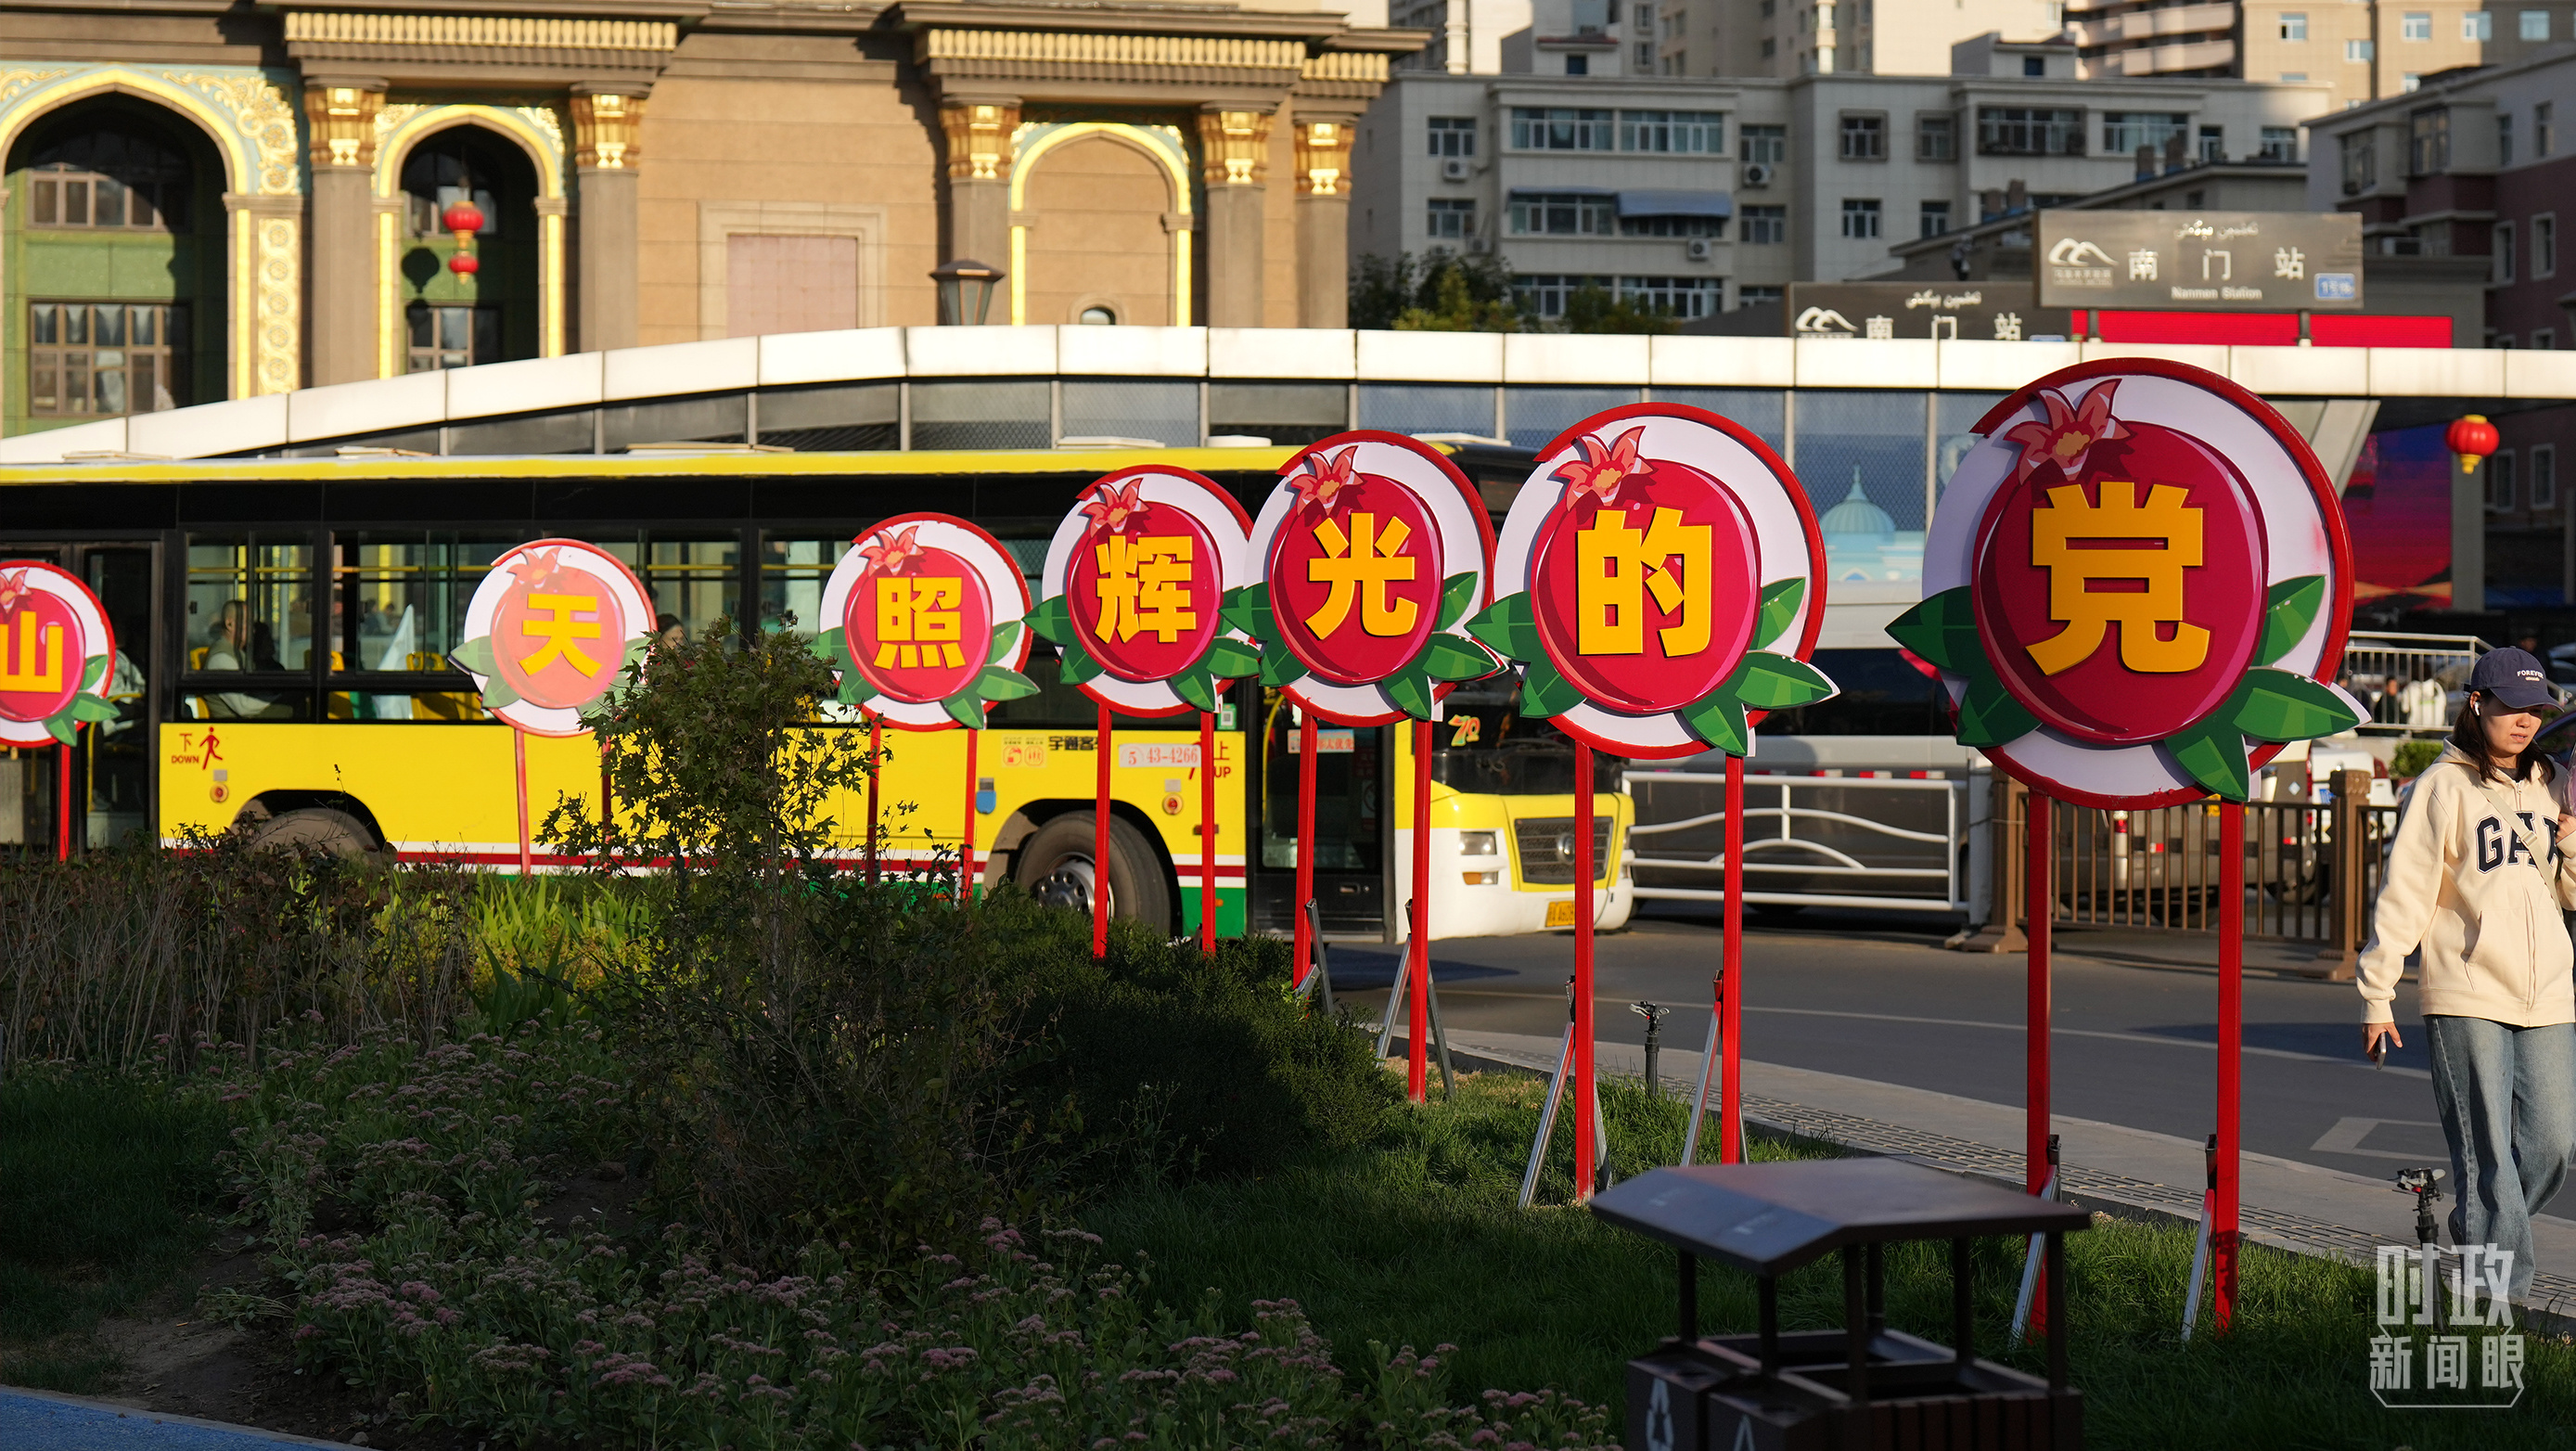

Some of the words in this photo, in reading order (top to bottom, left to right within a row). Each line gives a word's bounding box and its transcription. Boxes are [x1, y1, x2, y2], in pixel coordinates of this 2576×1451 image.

[2127, 246, 2306, 281] 南门站
[2172, 286, 2218, 300] Nanmen
[2222, 286, 2262, 300] Station
[1865, 312, 2022, 340] 南门站
[1095, 534, 1197, 644] 辉
[1304, 512, 1418, 640] 光
[1577, 507, 1712, 658] 的
[2028, 479, 2210, 675] 党
[519, 592, 603, 679] 天
[873, 576, 967, 670] 照
[0, 610, 64, 693] 山
[171, 755, 199, 764] DOWN
[179, 733, 193, 751] 下
[1146, 745, 1199, 764] 43-4266
[1212, 740, 1230, 761] 上
[1212, 766, 1232, 778] UP
